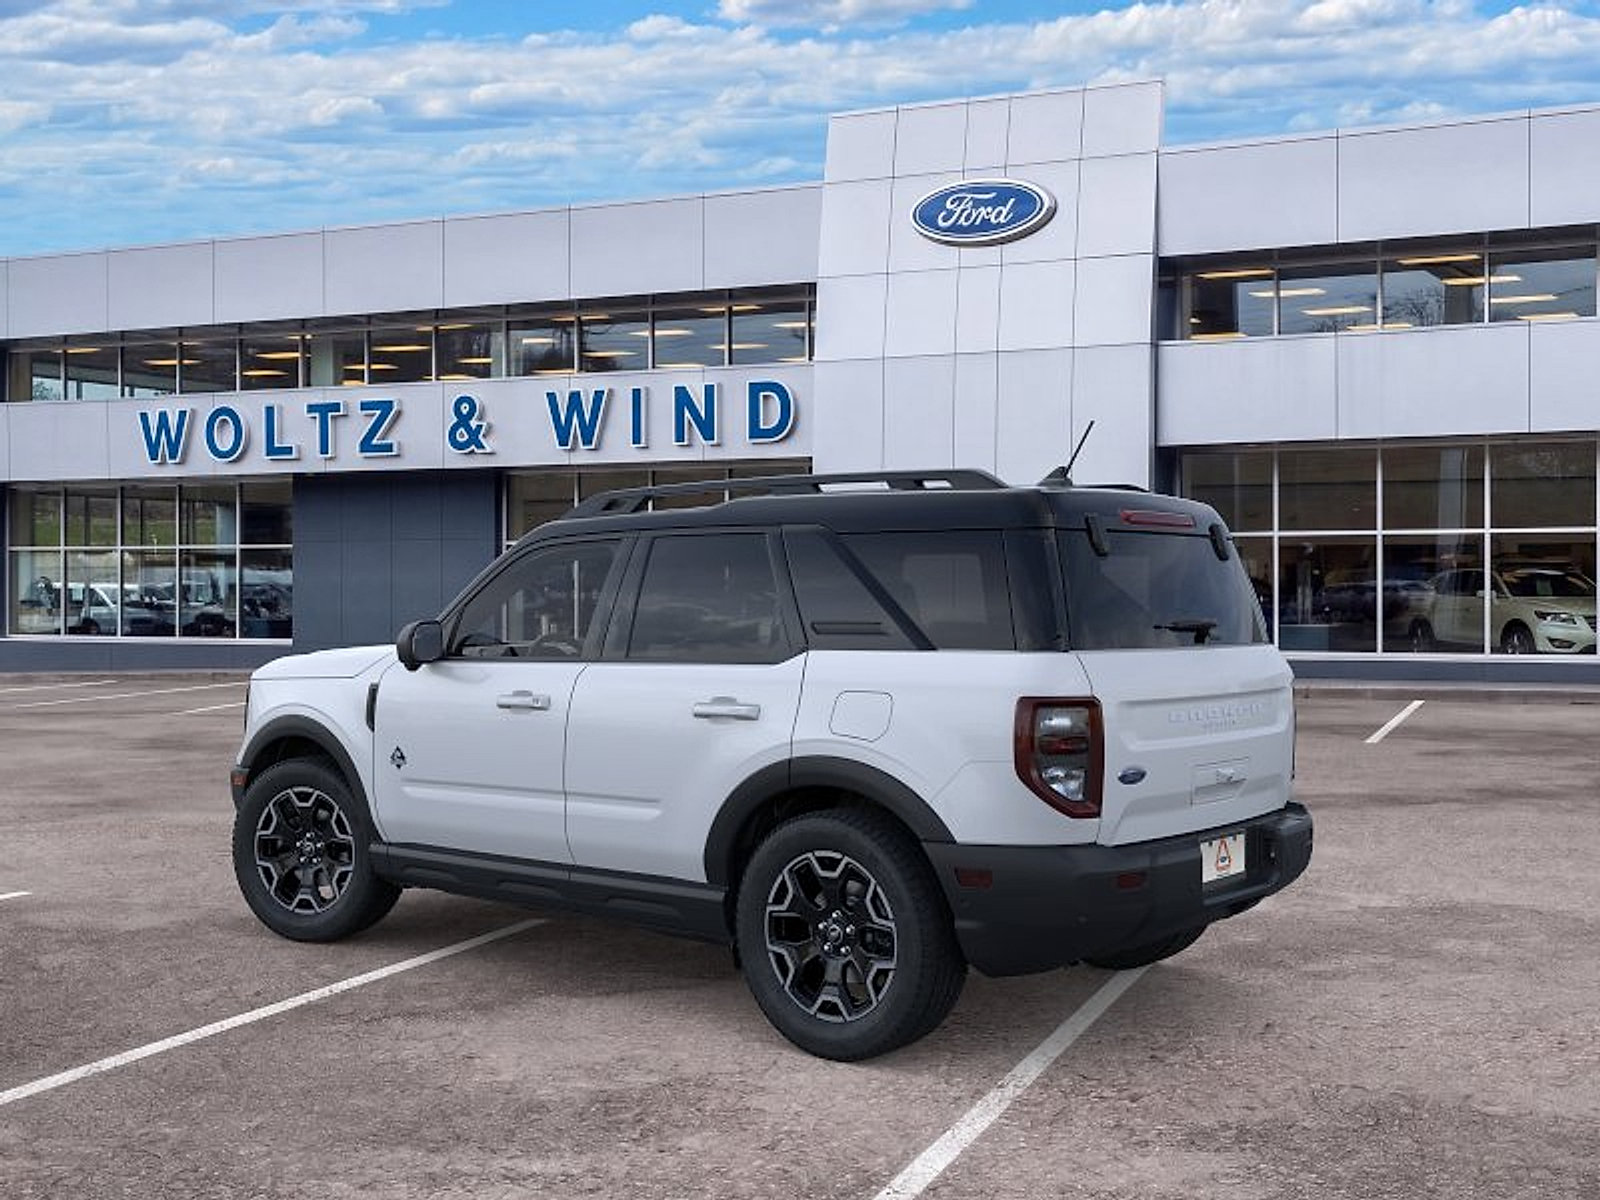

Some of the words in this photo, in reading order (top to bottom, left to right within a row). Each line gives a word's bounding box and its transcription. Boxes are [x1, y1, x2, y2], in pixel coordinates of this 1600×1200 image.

[937, 191, 1016, 228] Ford
[138, 399, 401, 464] WOLTZ
[447, 394, 494, 454] &
[545, 379, 795, 450] WIND
